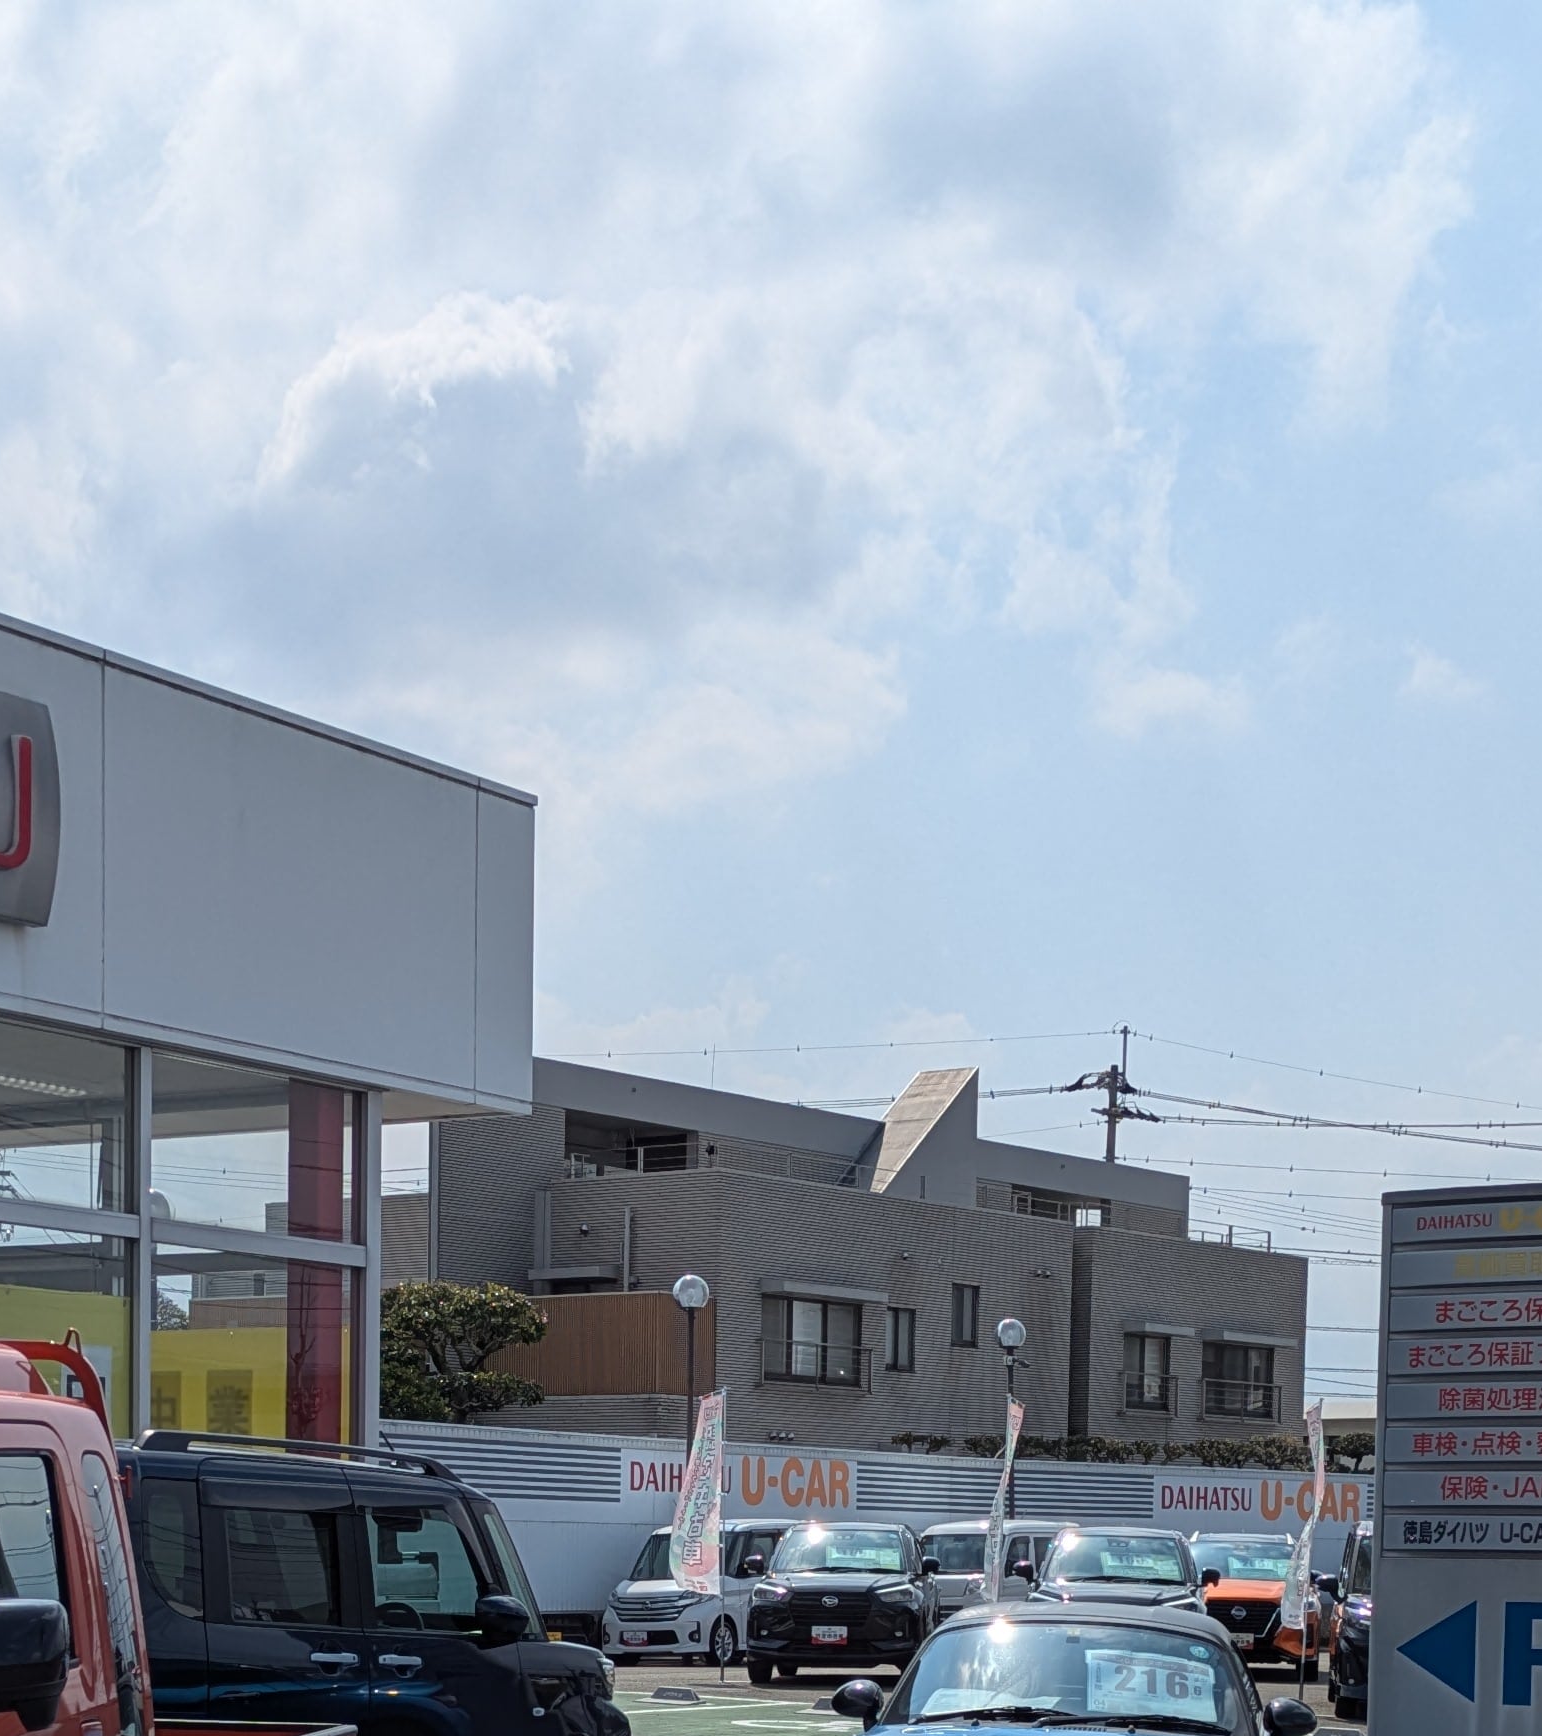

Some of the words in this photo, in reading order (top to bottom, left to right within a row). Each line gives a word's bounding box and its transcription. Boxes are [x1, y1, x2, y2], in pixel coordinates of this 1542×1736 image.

[1417, 1213, 1492, 1231] DAIHATSU
[629, 1459, 732, 1496] DAIHU
[741, 1455, 850, 1508] U-CAR
[1161, 1484, 1252, 1513] DAIHATSU
[1260, 1479, 1359, 1522] U-CAR
[1403, 1520, 1489, 1545] 徳島ダイハツ
